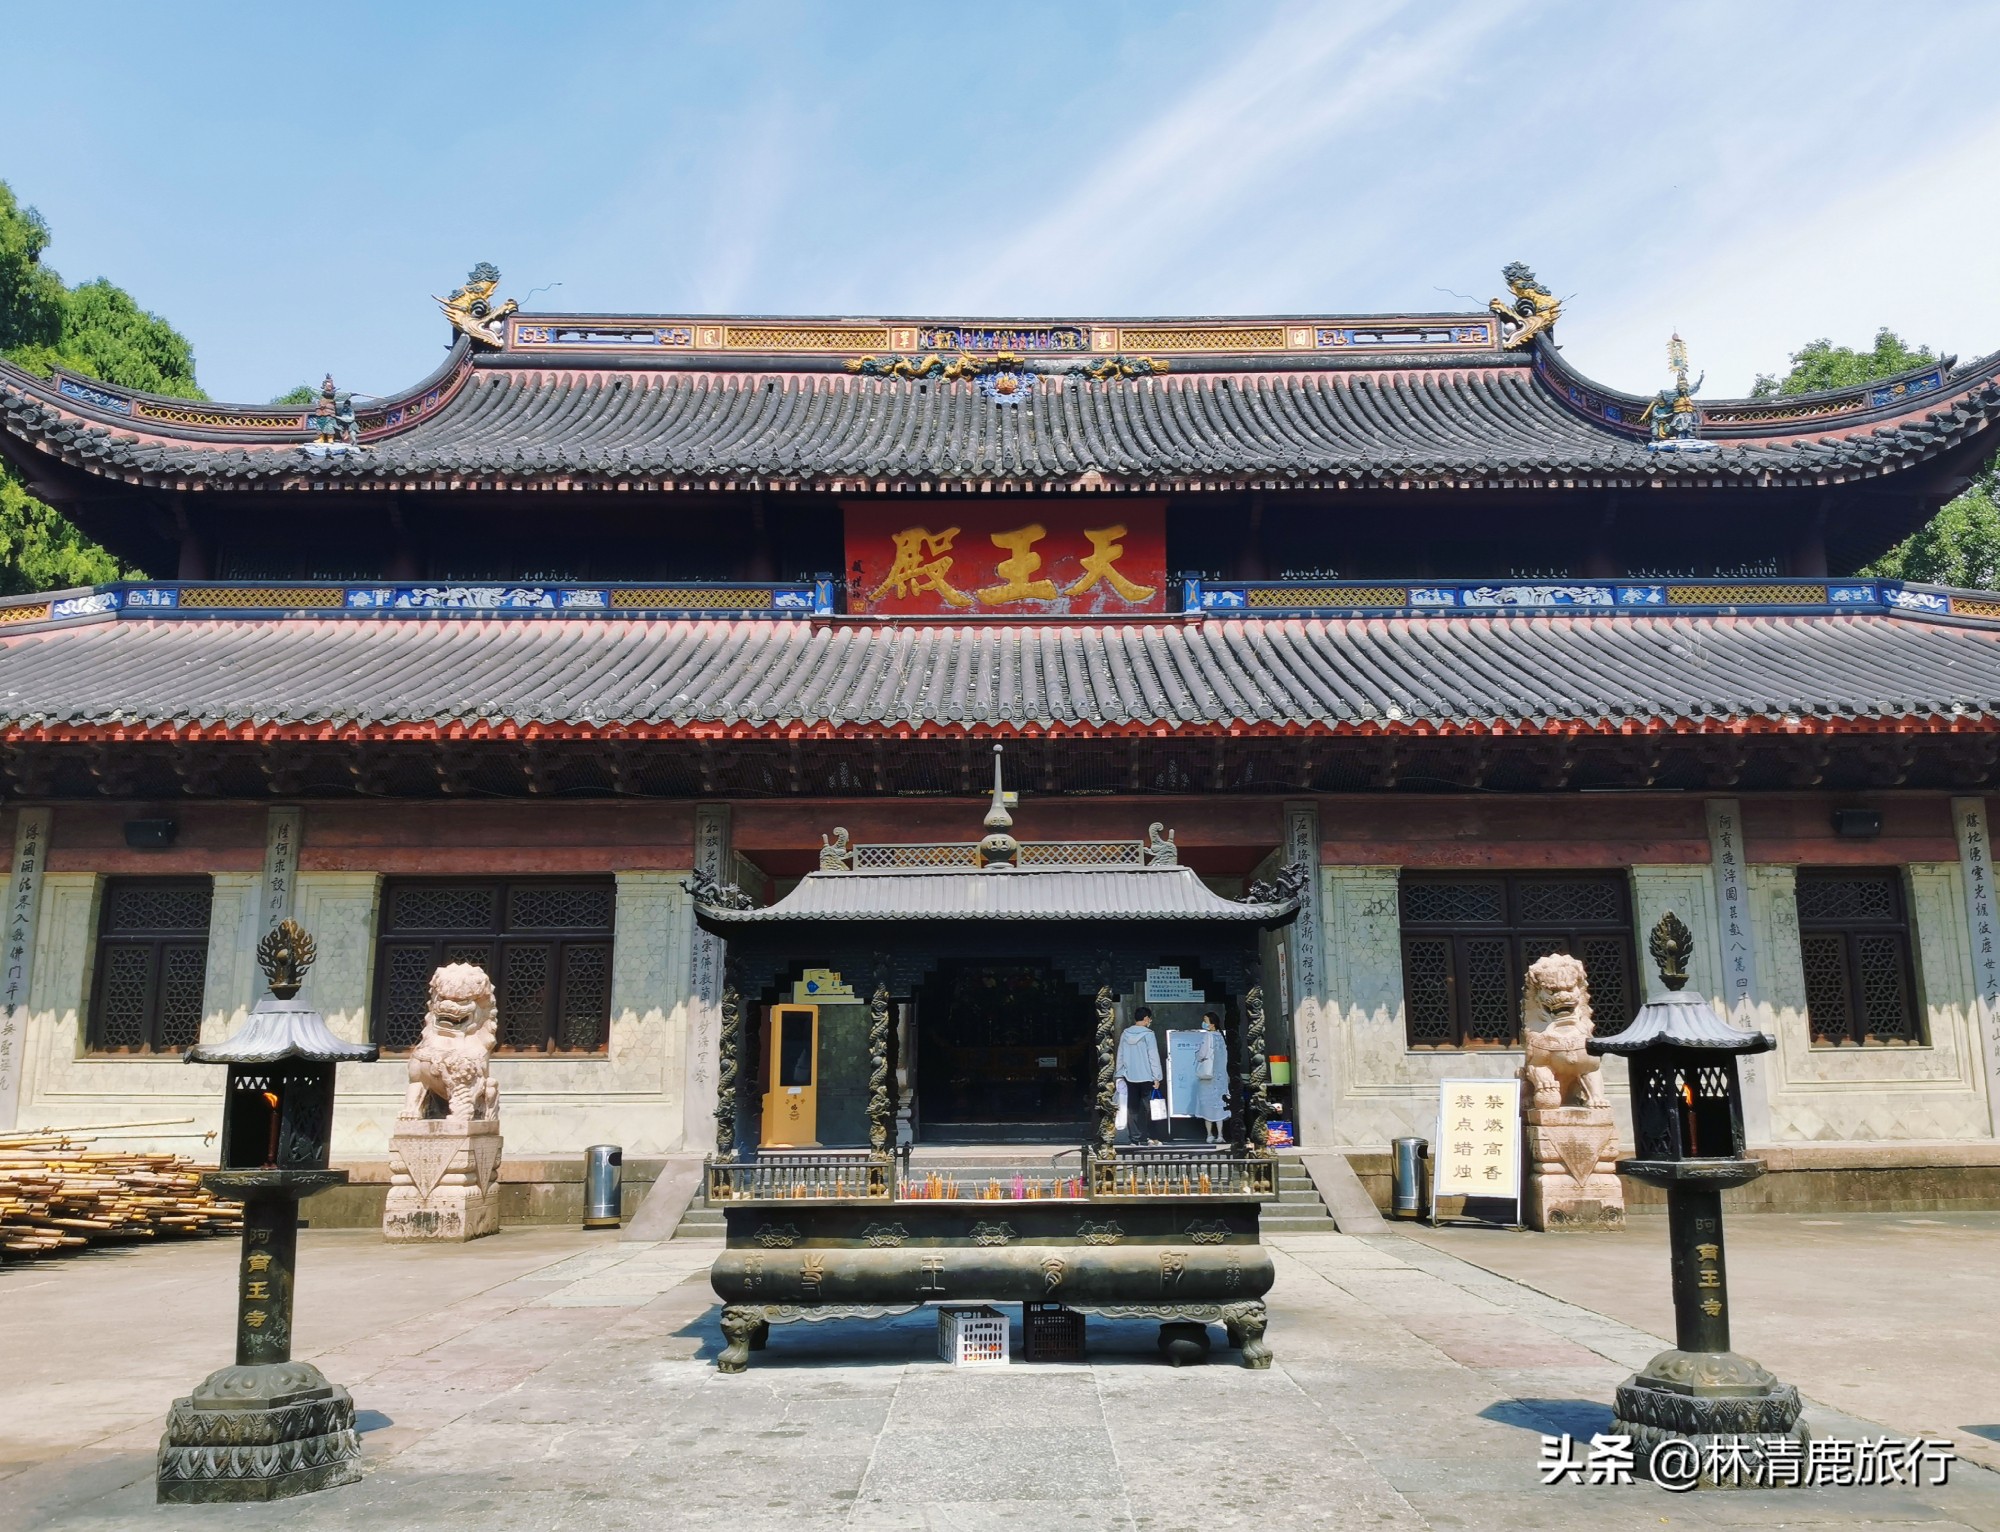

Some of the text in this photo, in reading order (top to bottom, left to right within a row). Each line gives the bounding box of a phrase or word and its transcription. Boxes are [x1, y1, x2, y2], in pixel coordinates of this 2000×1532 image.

[869, 523, 1156, 606] 天王殿
[1453, 1094, 1475, 1180] 禁点蜡烛
[1483, 1094, 1505, 1180] 禁燃高香
[243, 1228, 273, 1329] 阿育王寺
[1694, 1217, 1723, 1318] 阿育王寺
